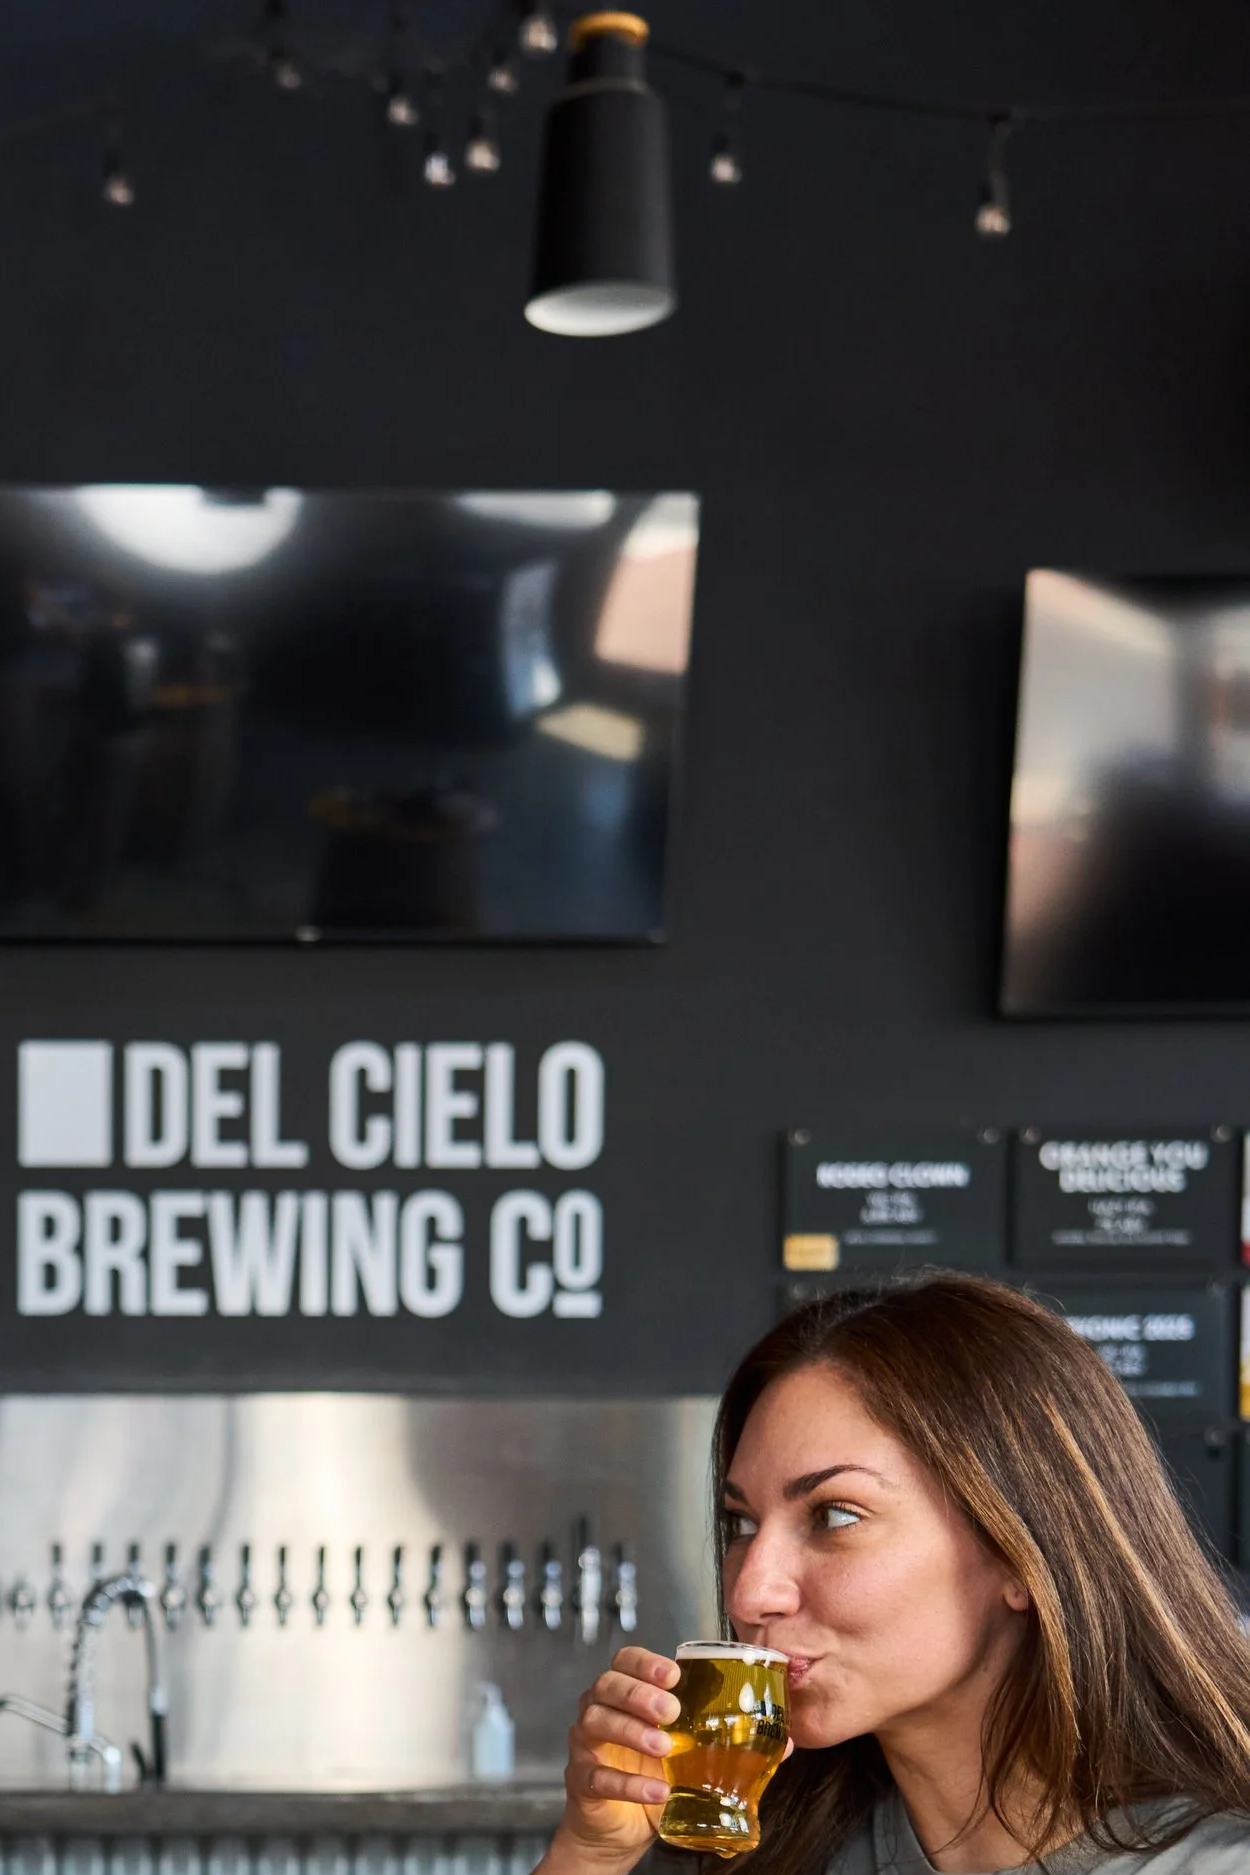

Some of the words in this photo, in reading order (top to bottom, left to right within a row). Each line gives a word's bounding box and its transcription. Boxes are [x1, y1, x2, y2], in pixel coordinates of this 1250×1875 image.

[123, 1040, 309, 1168] DEL
[328, 1040, 605, 1170] CIELO
[1149, 1139, 1210, 1170] YOU
[888, 1160, 971, 1189] CLOWN
[1058, 1164, 1188, 1193] DELICIOUS
[16, 1189, 464, 1318] BREWING
